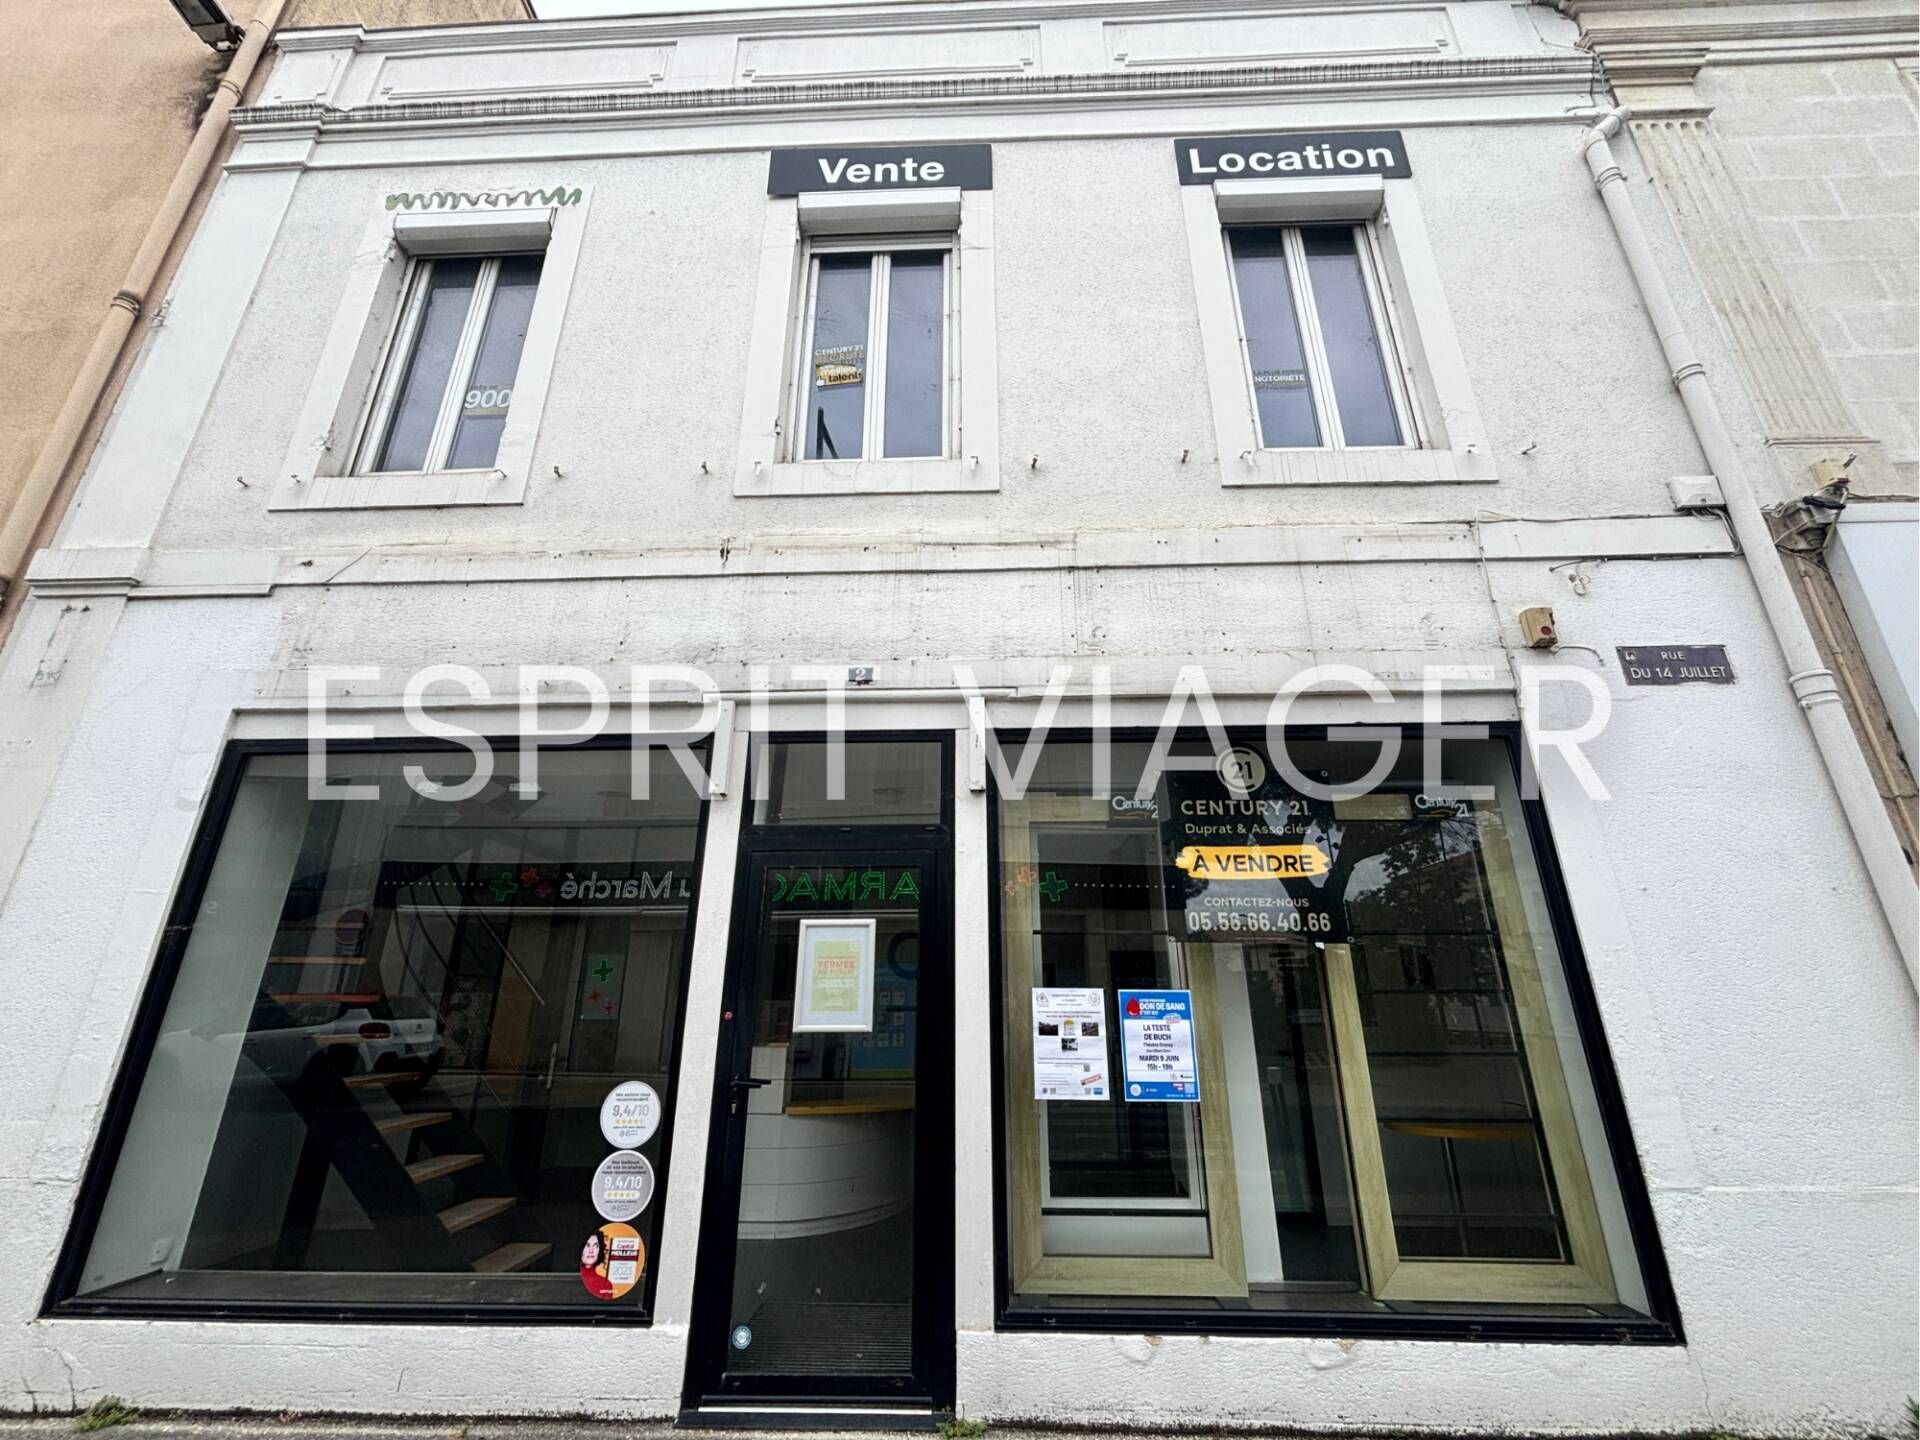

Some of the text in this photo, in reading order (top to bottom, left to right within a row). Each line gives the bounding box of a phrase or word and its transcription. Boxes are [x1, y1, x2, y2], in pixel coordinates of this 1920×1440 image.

[1188, 143, 1395, 174] Location
[818, 158, 945, 184] Vente
[1660, 651, 1686, 660] RUE
[855, 667, 866, 681] 2
[1630, 666, 1725, 679] DU 14 JUILLET
[1231, 761, 1253, 780] 21
[1112, 796, 1155, 810] Century
[1180, 800, 1282, 816] CENTURY
[1415, 794, 1457, 809] Century
[1185, 822, 1312, 836] Duprat & Associés
[1192, 849, 1315, 873] À VENDRE
[1204, 897, 1310, 907] CONTACTEZ-NOUS
[1188, 911, 1332, 932] 05.56.66.40.66
[1139, 1002, 1186, 1011] DON DE SANG
[1143, 1033, 1172, 1041] DE BUCH
